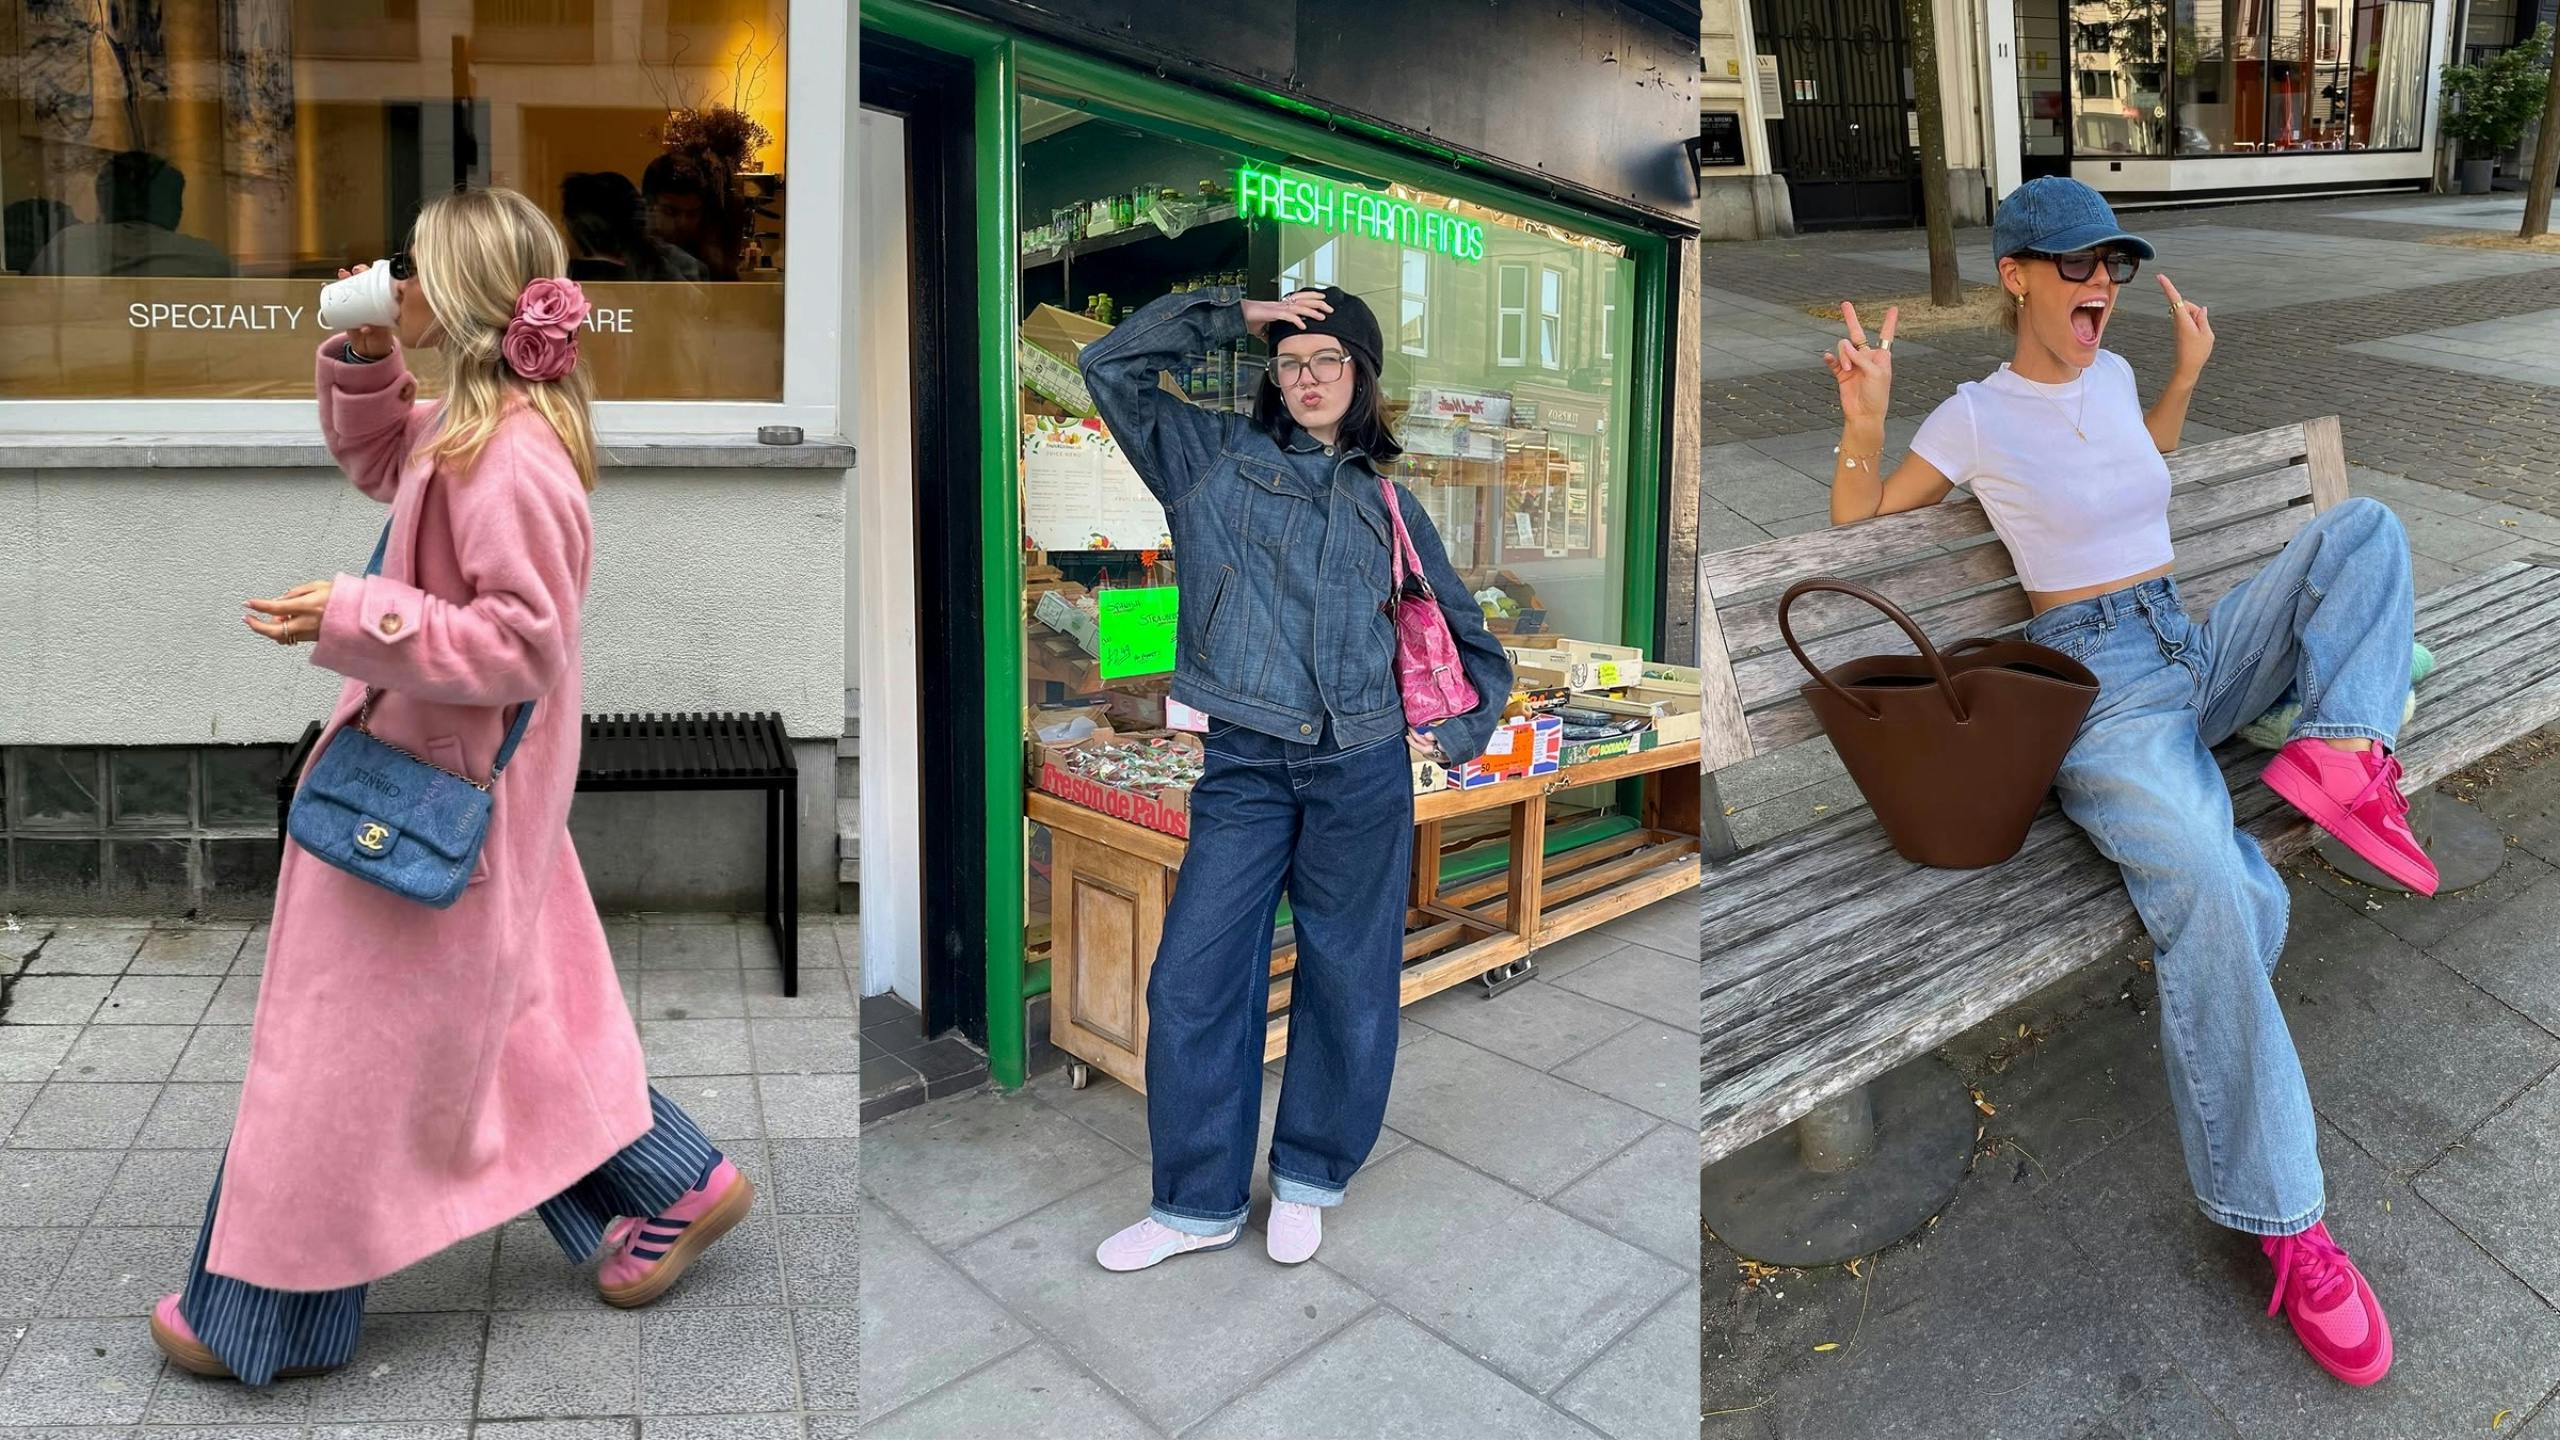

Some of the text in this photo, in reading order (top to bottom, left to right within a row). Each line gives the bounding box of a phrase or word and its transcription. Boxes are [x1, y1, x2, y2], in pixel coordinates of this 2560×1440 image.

[1240, 169, 1485, 261] FRESH FARM FINDS
[128, 303, 304, 330] SPECIALTY
[354, 766, 401, 799] CHANEL
[1106, 788, 1130, 821] de
[1132, 794, 1187, 838] Palos
